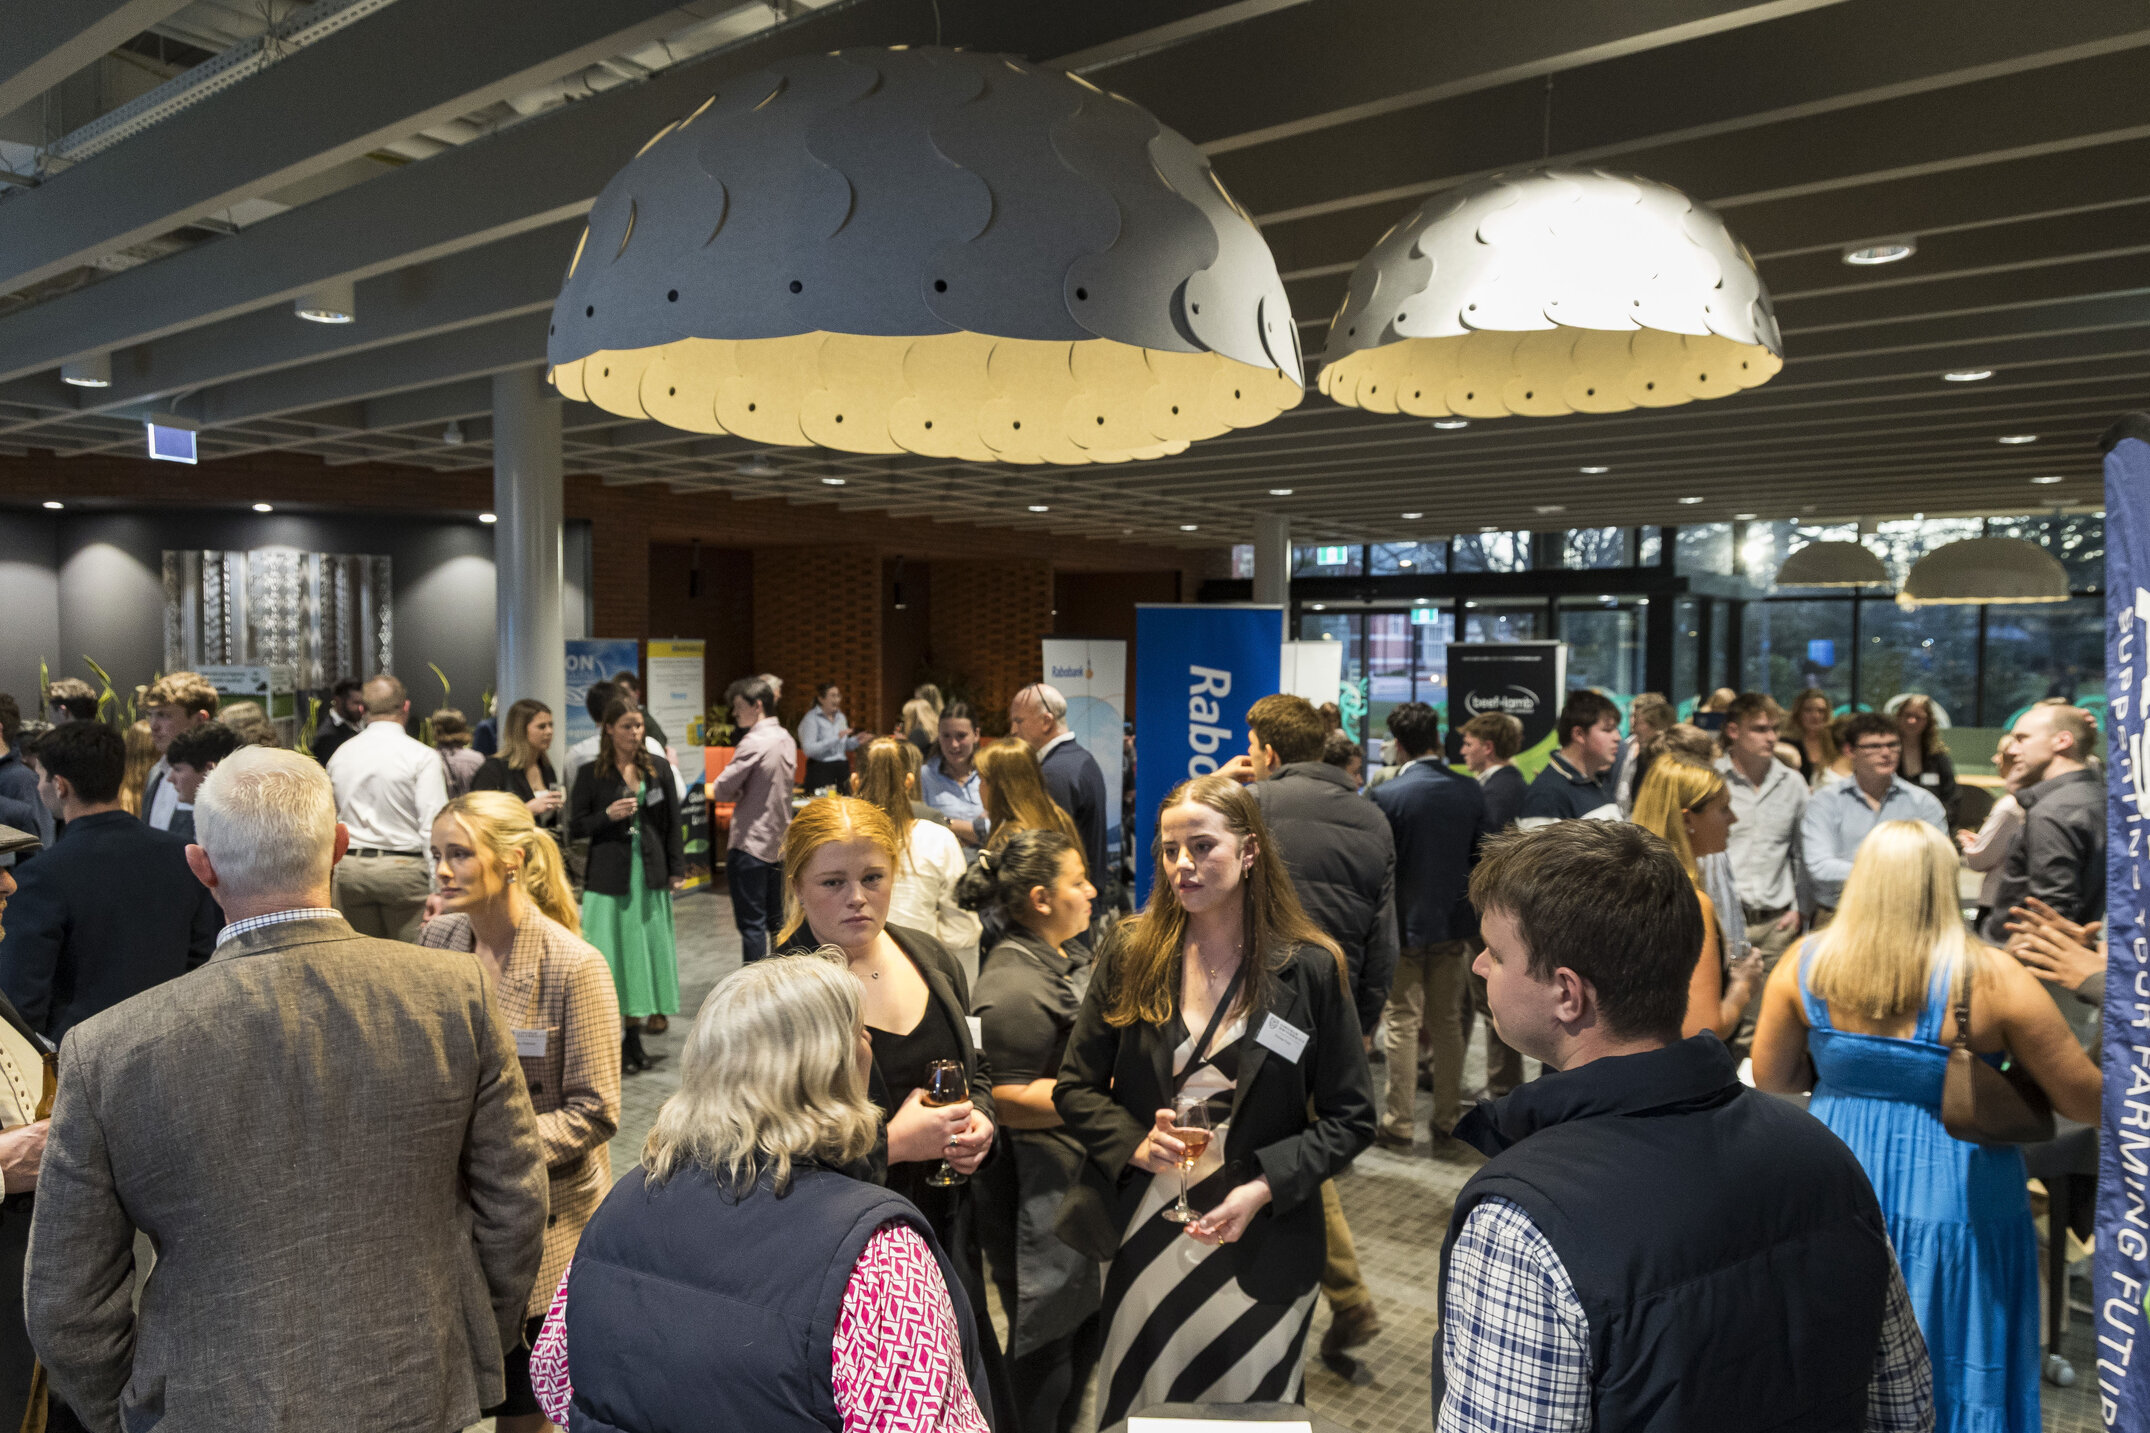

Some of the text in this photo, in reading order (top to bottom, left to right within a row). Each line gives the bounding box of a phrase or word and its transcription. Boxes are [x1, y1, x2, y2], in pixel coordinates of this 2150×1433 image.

[1052, 665, 1083, 677] Rabobank
[1188, 664, 1232, 780] Rabo
[2118, 1045, 2150, 1262] FARMING
